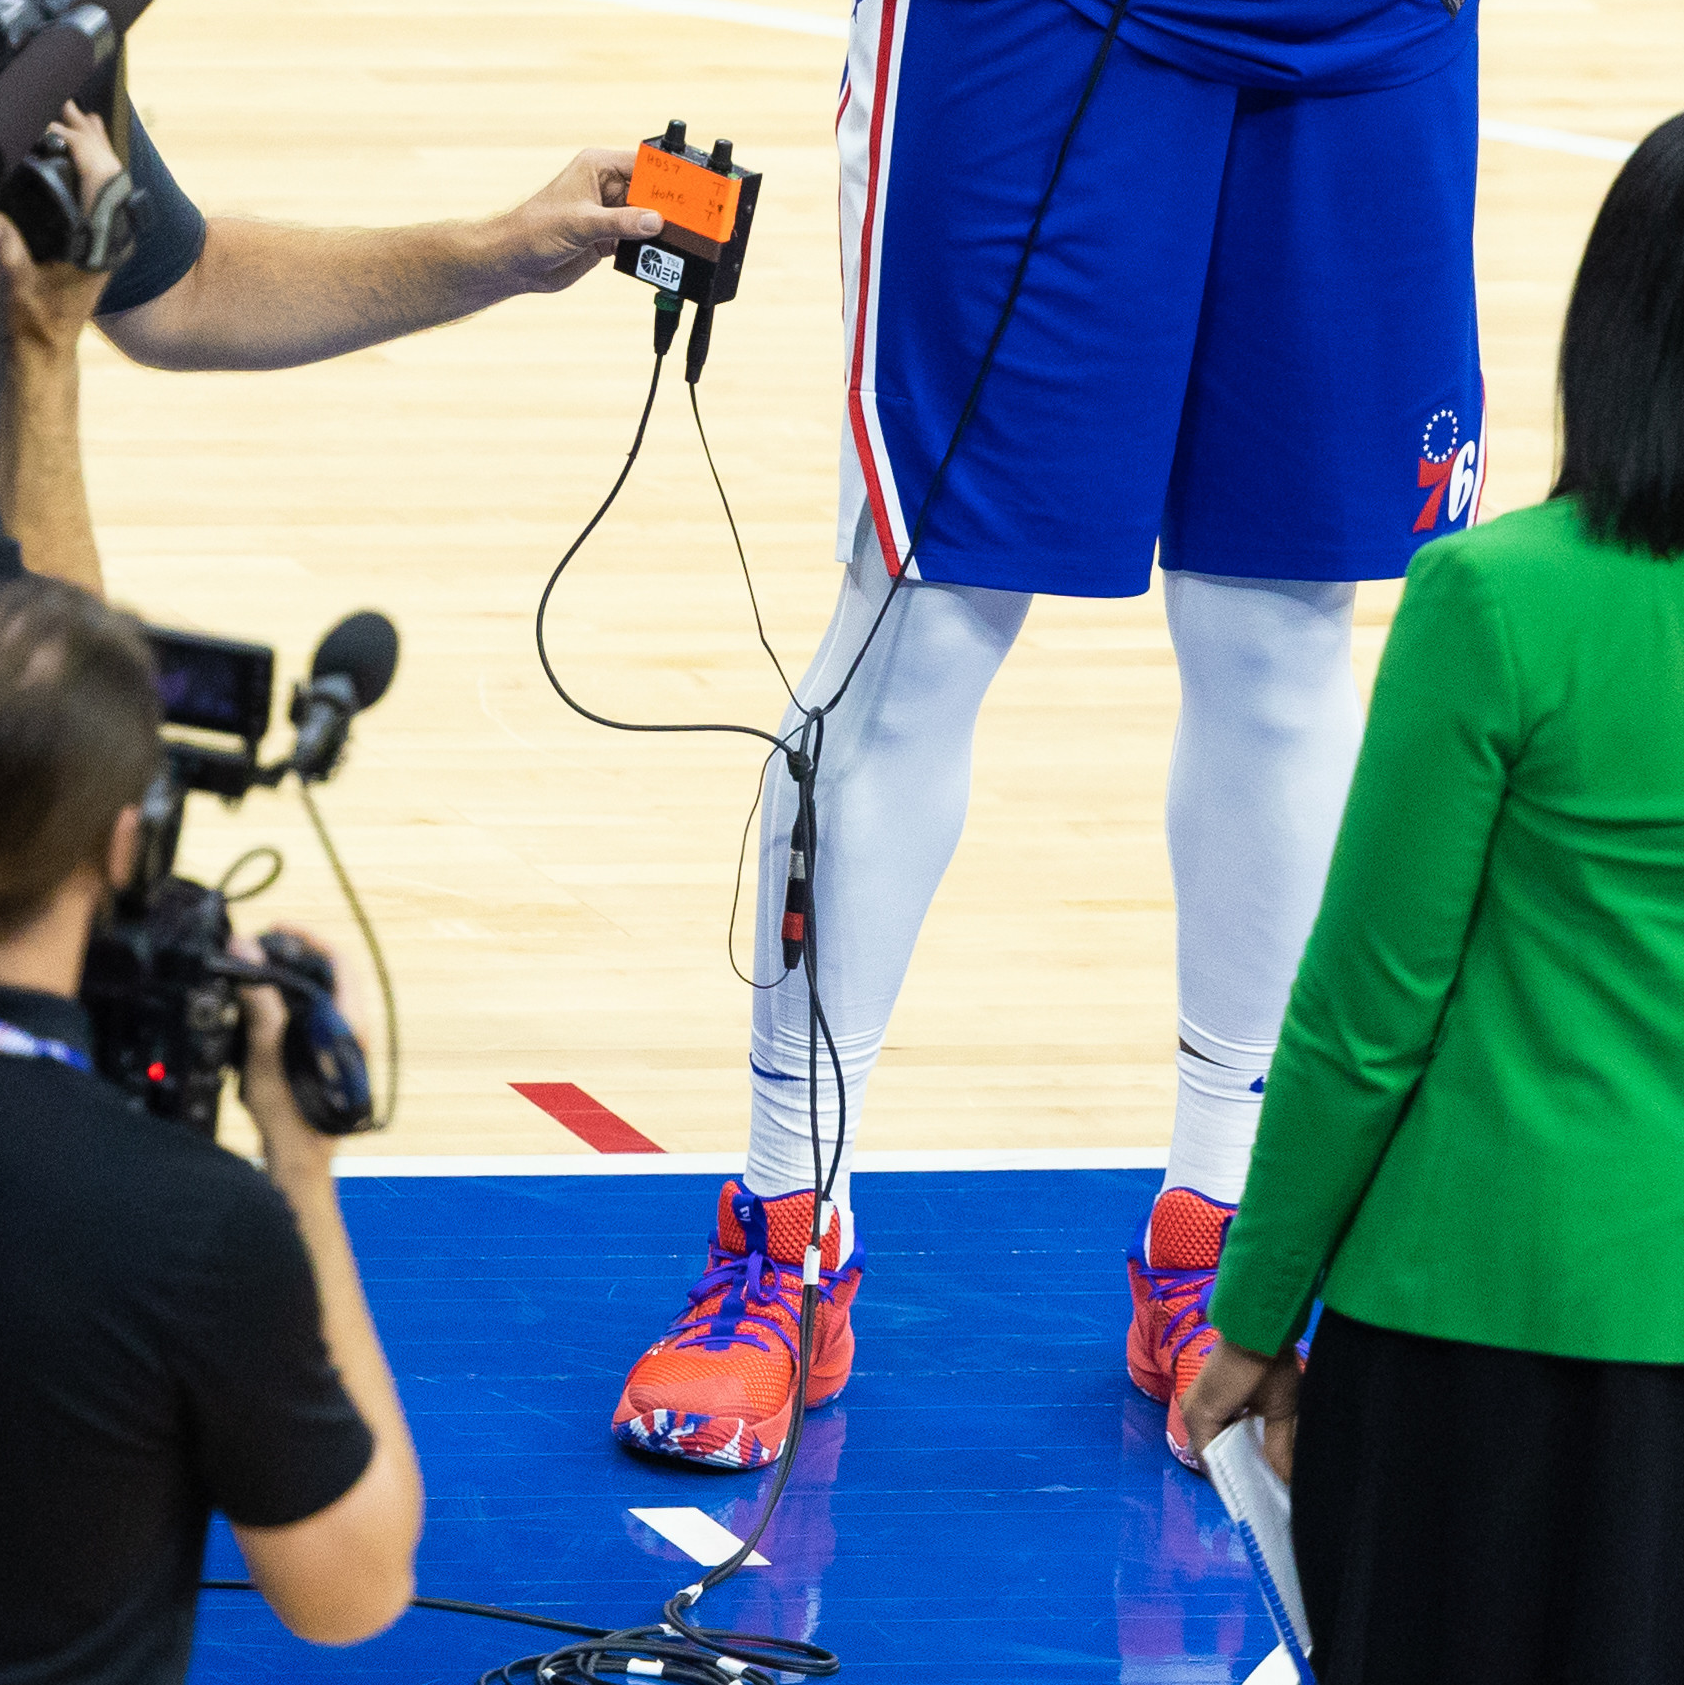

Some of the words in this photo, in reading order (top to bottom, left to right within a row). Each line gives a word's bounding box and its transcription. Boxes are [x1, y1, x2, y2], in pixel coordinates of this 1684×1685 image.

[647, 153, 681, 175] HOST
[651, 184, 686, 205] HOME
[651, 263, 681, 284] NEP
[1413, 439, 1476, 533] 76
